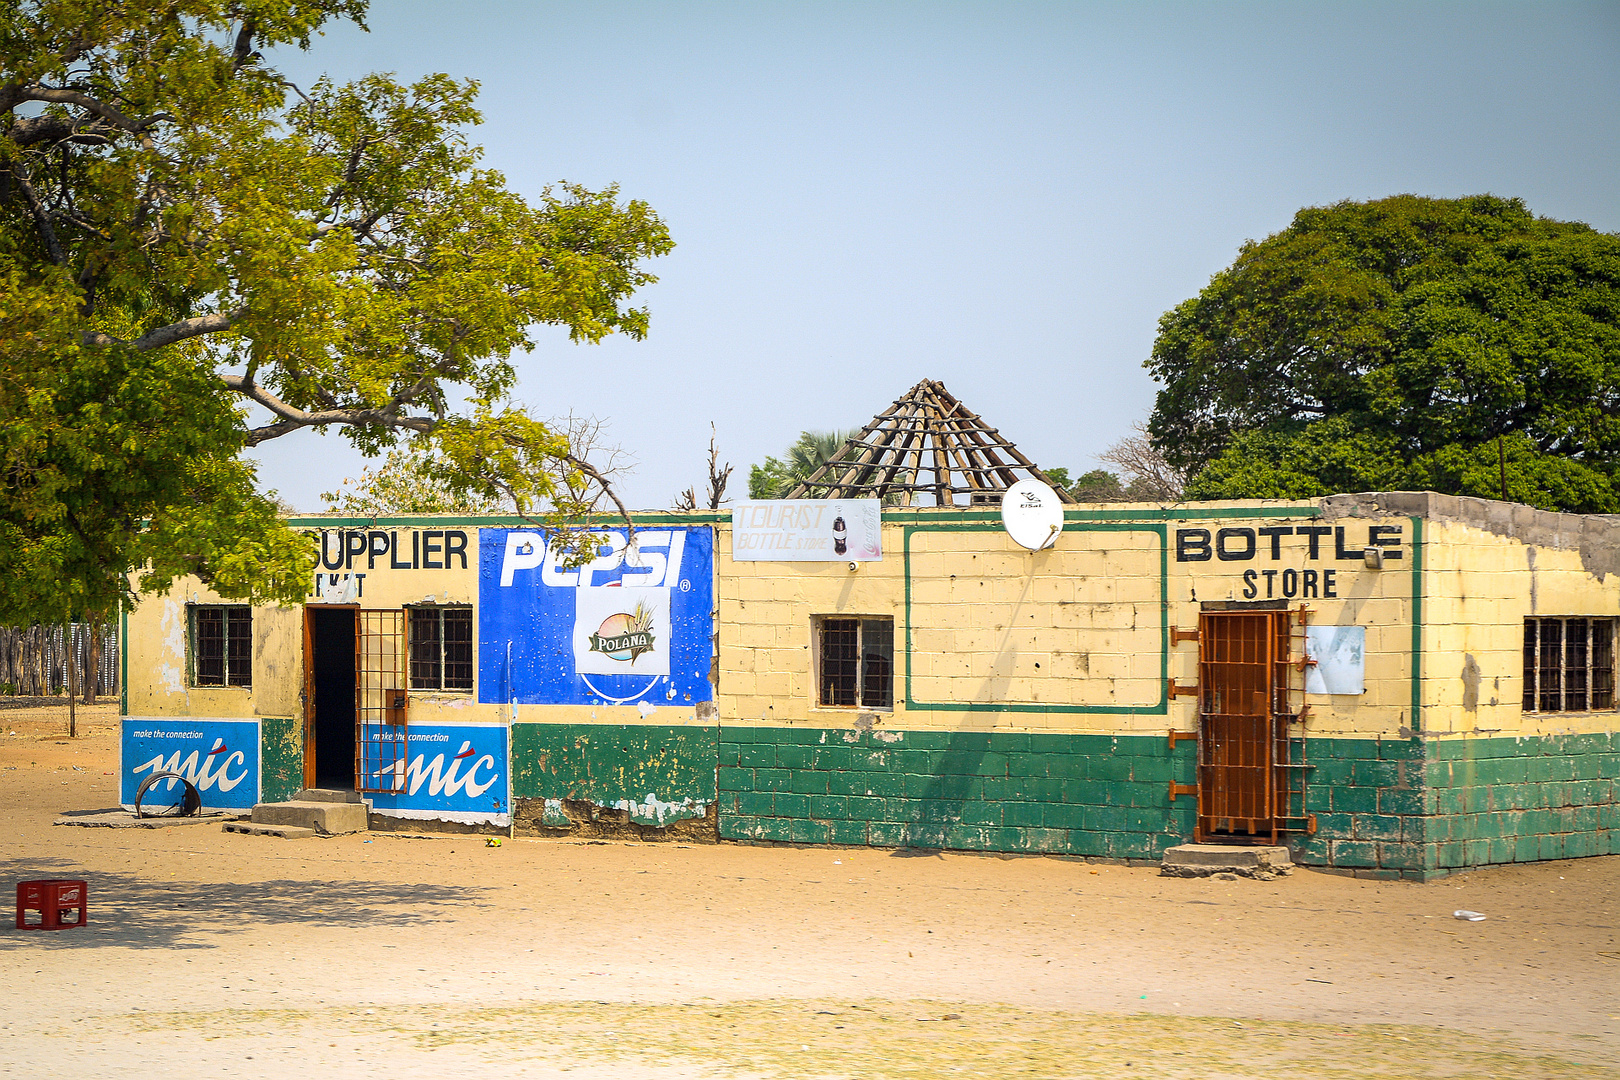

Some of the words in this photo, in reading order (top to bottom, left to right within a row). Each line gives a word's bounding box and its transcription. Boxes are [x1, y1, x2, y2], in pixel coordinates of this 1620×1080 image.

[736, 505, 827, 529] TOURIST
[737, 532, 797, 550] BOTTLE
[795, 537, 828, 550] STORE
[1176, 525, 1403, 562] BOTTLE
[500, 530, 687, 587] PEPSI
[1243, 568, 1337, 598] STORE
[598, 634, 647, 651] POLANA
[133, 730, 152, 738] make
[153, 729, 165, 738] the
[166, 730, 204, 739] connection
[408, 732, 449, 742] connection
